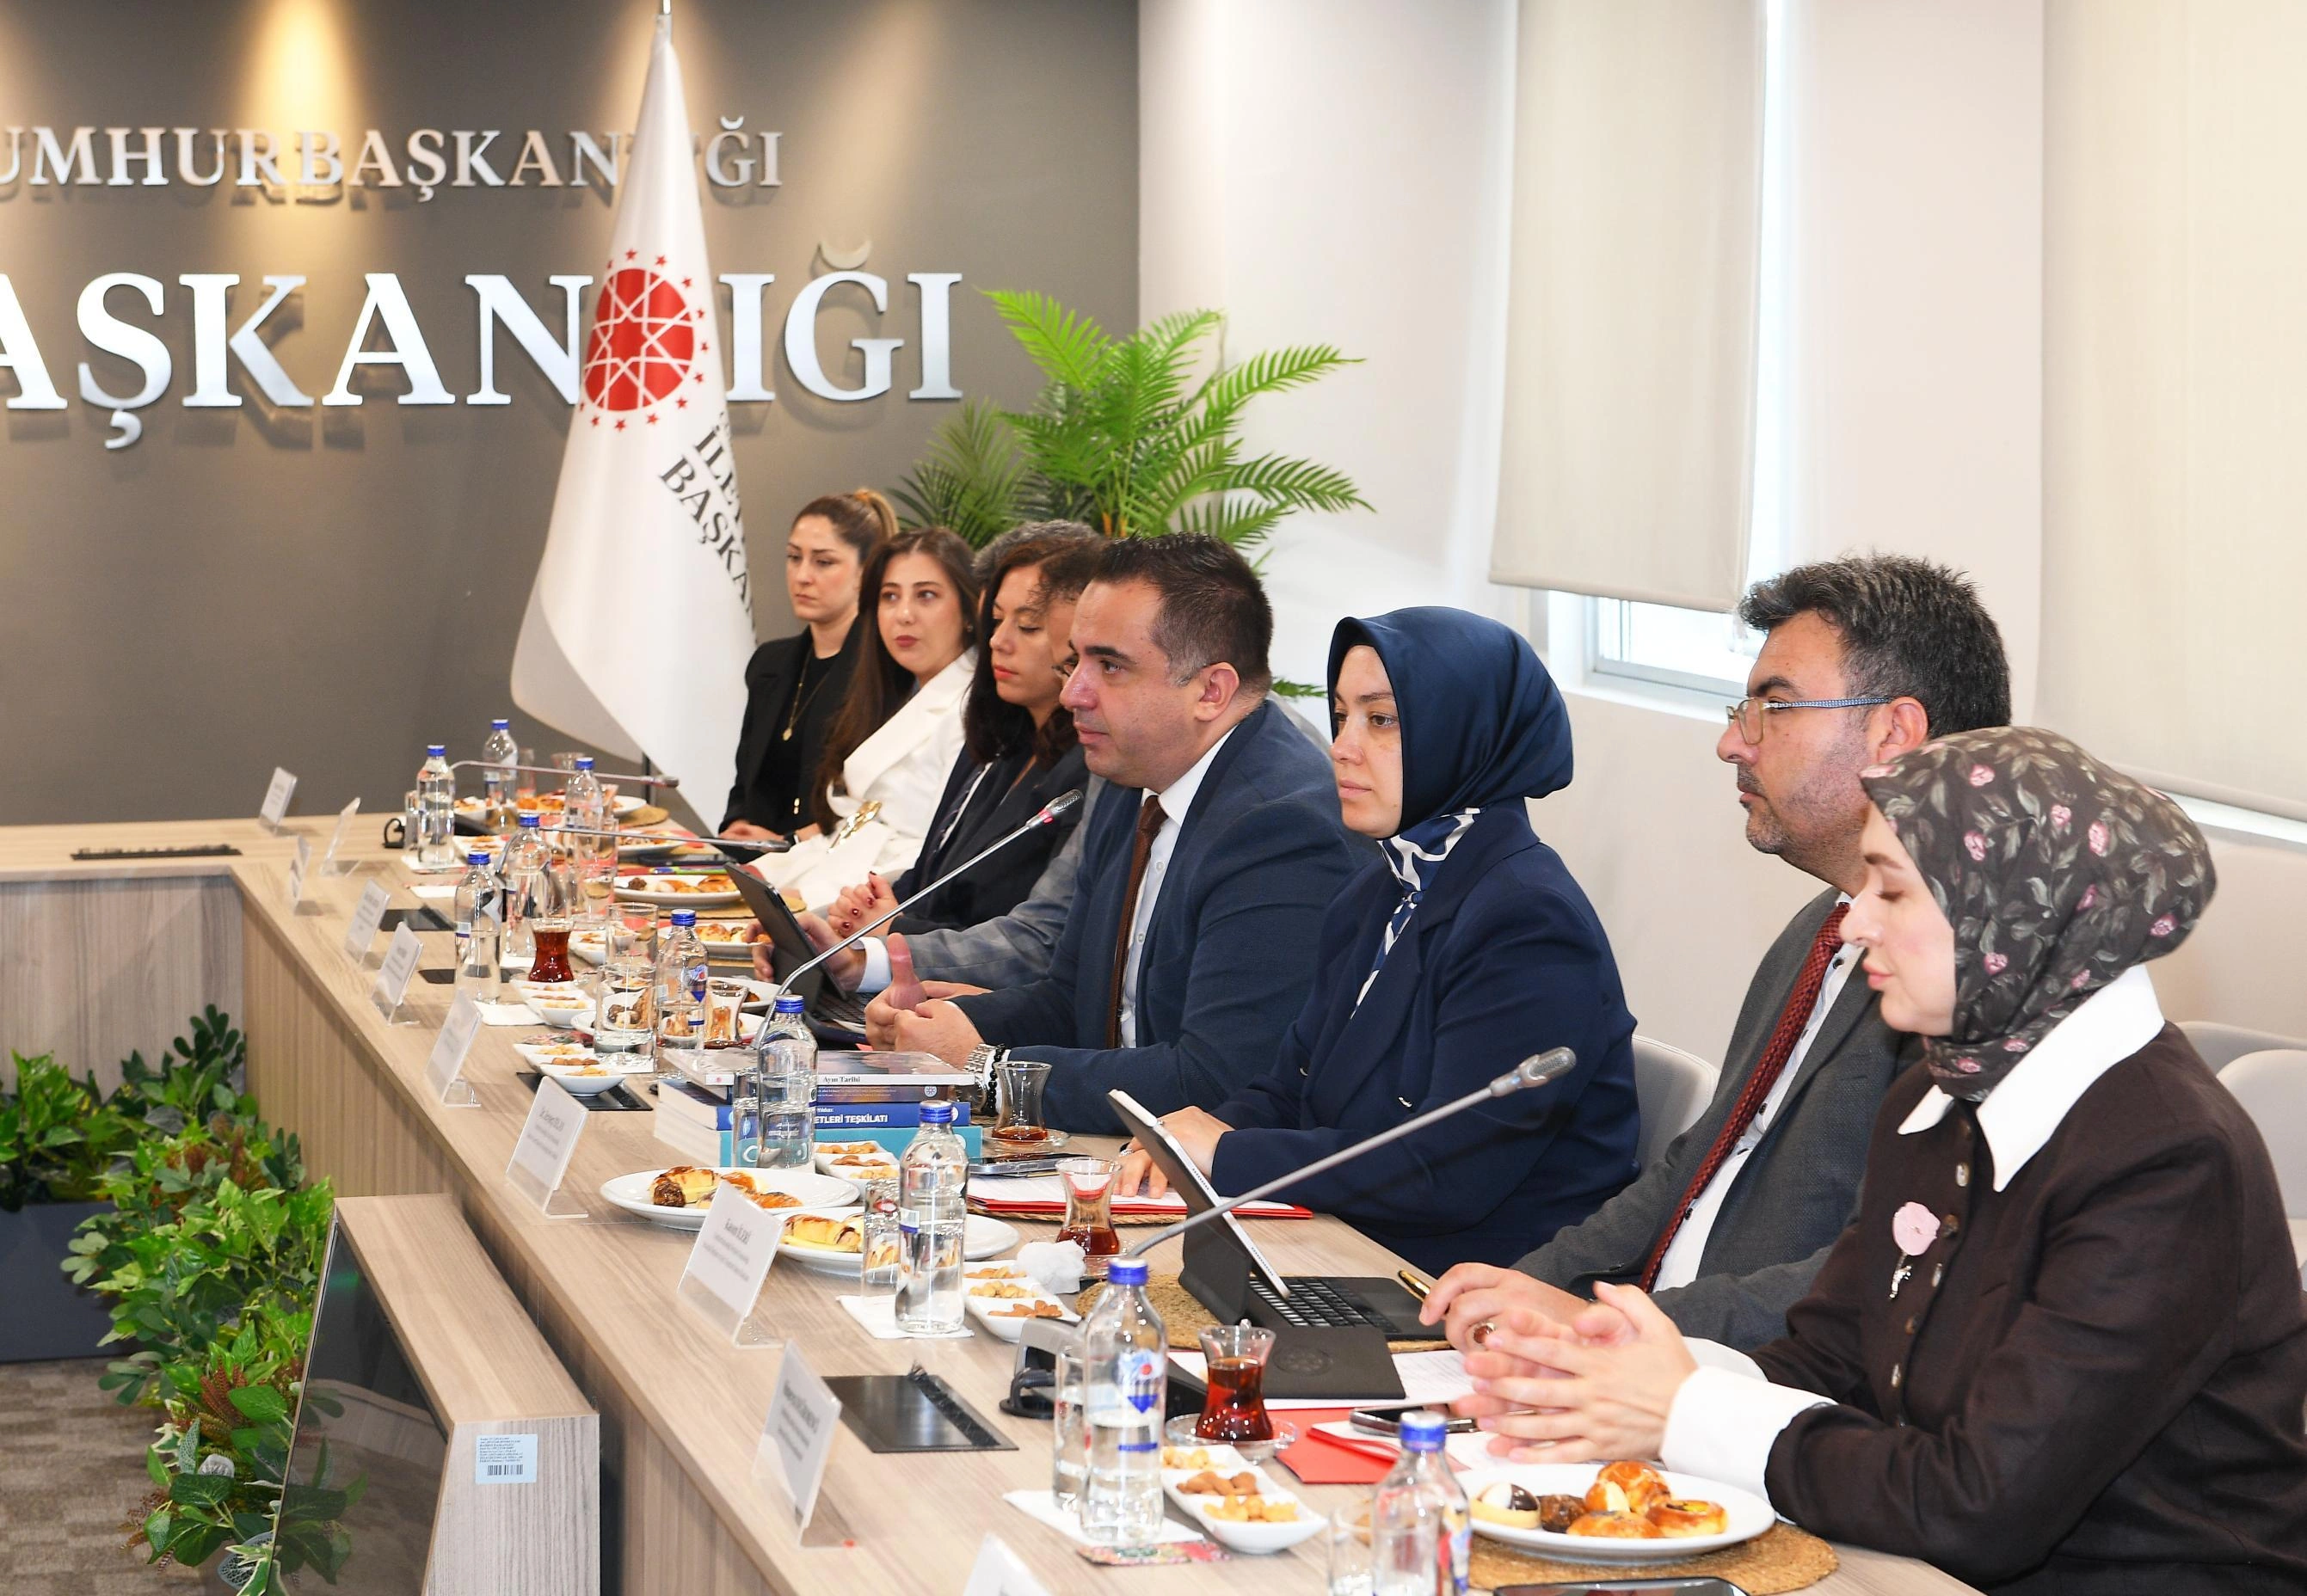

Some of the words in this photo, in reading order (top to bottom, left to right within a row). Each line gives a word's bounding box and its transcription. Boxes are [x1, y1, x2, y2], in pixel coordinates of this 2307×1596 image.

[0, 115, 783, 203] MHURBAŞKANĞI
[0, 239, 963, 450] AŞKANIĞI
[659, 455, 754, 614] BAŞKA
[844, 1113, 889, 1125] TEŞKİLATI
